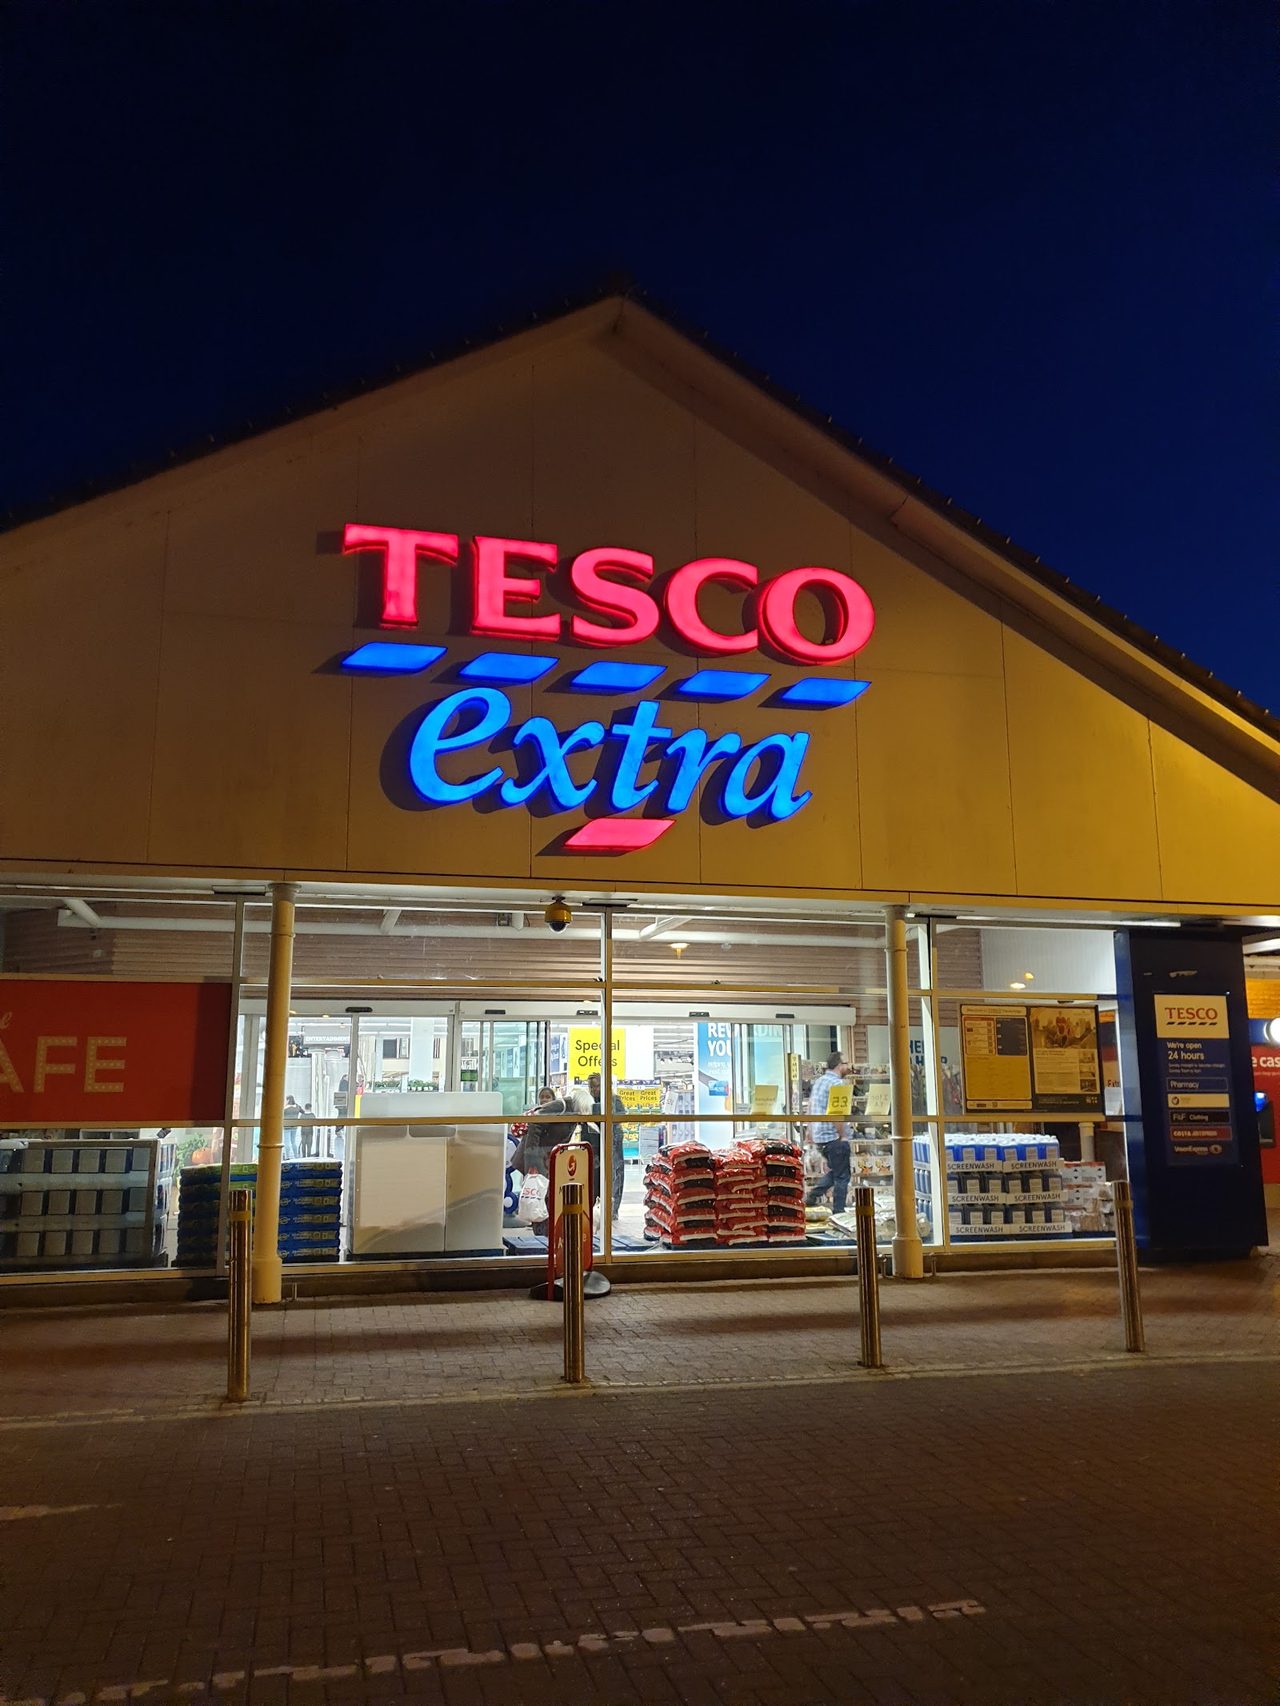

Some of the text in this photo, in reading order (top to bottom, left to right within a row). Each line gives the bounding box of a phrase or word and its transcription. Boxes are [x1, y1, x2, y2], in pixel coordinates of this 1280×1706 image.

[343, 523, 876, 665] TESCO
[409, 687, 813, 820] extra
[1165, 1007, 1218, 1020] TESCO
[575, 1040, 620, 1053] Speal
[1168, 1051, 1204, 1060] 24 hours
[577, 1056, 618, 1067] Offes
[948, 1161, 1057, 1170] SCREENWASH SCREENWASH
[952, 1193, 1061, 1202] SCREENWASH SCREENWASH
[956, 1226, 1004, 1234] SCREENWASH
